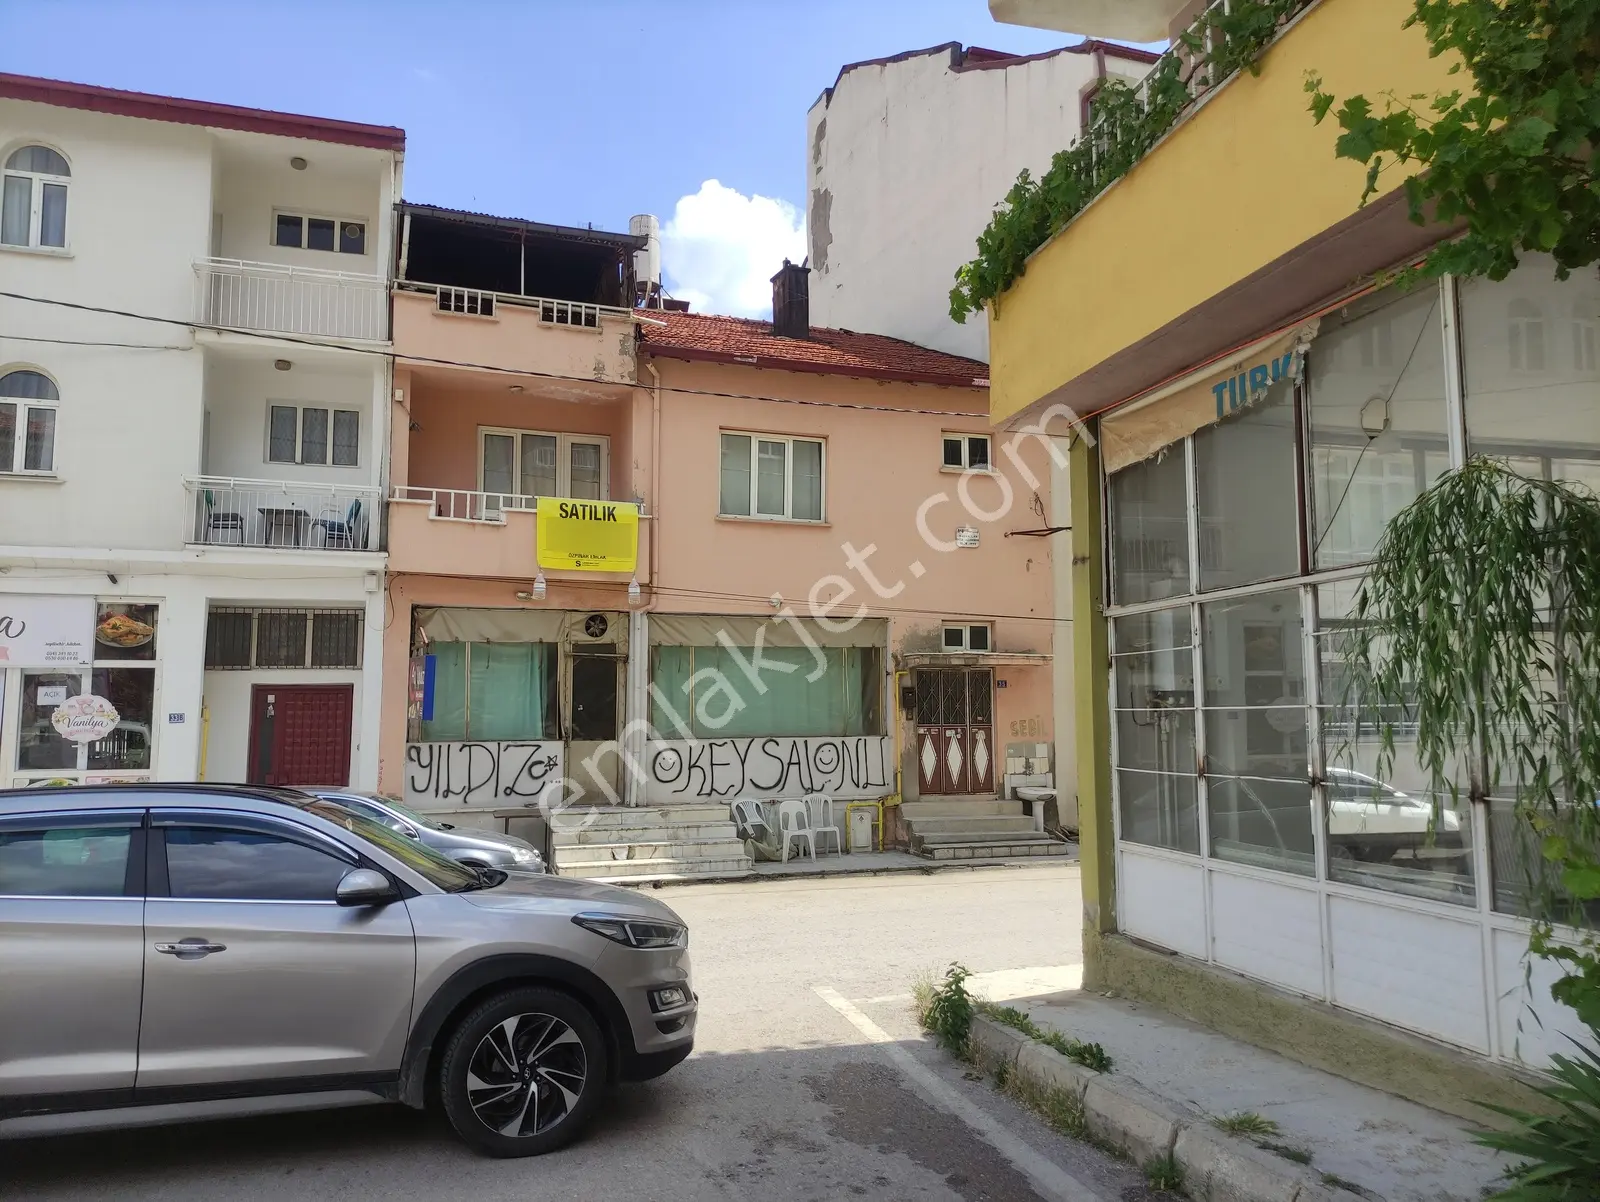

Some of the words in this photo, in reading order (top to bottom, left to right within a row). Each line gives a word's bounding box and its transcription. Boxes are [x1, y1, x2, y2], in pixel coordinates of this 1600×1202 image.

[559, 502, 617, 522] SATILIK
[63, 715, 109, 729] Vanilya
[408, 742, 546, 803] YILDIZ
